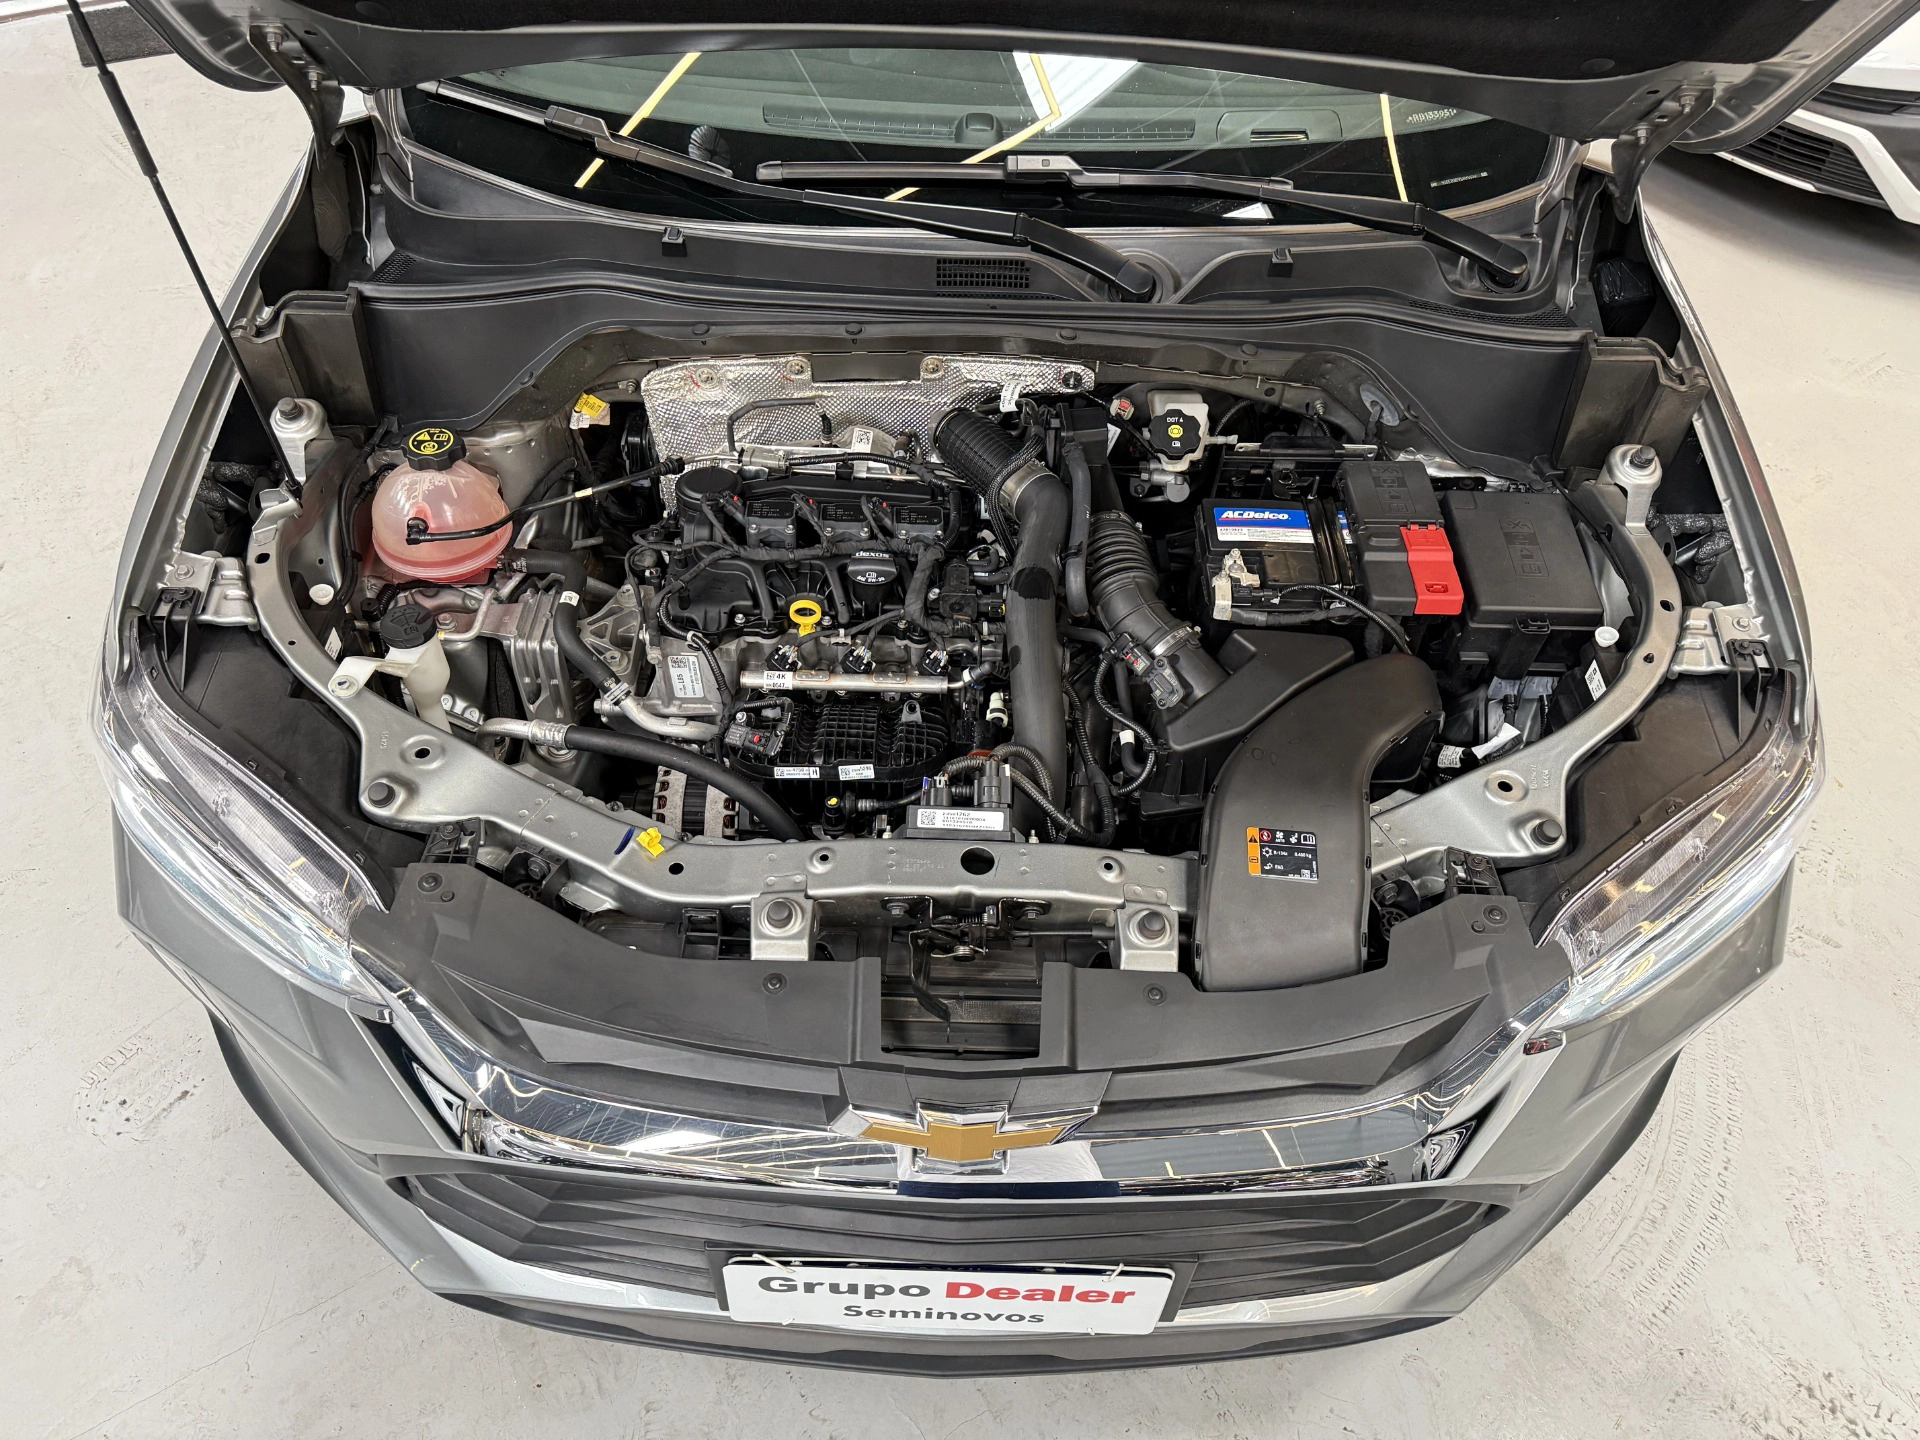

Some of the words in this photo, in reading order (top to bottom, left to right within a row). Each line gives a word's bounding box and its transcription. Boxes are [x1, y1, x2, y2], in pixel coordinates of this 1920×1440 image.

[1221, 510, 1289, 520] ACDelco
[758, 1276, 930, 1299] Grupo
[946, 1282, 1136, 1304] Dealer
[843, 1305, 1045, 1323] Seminovos
